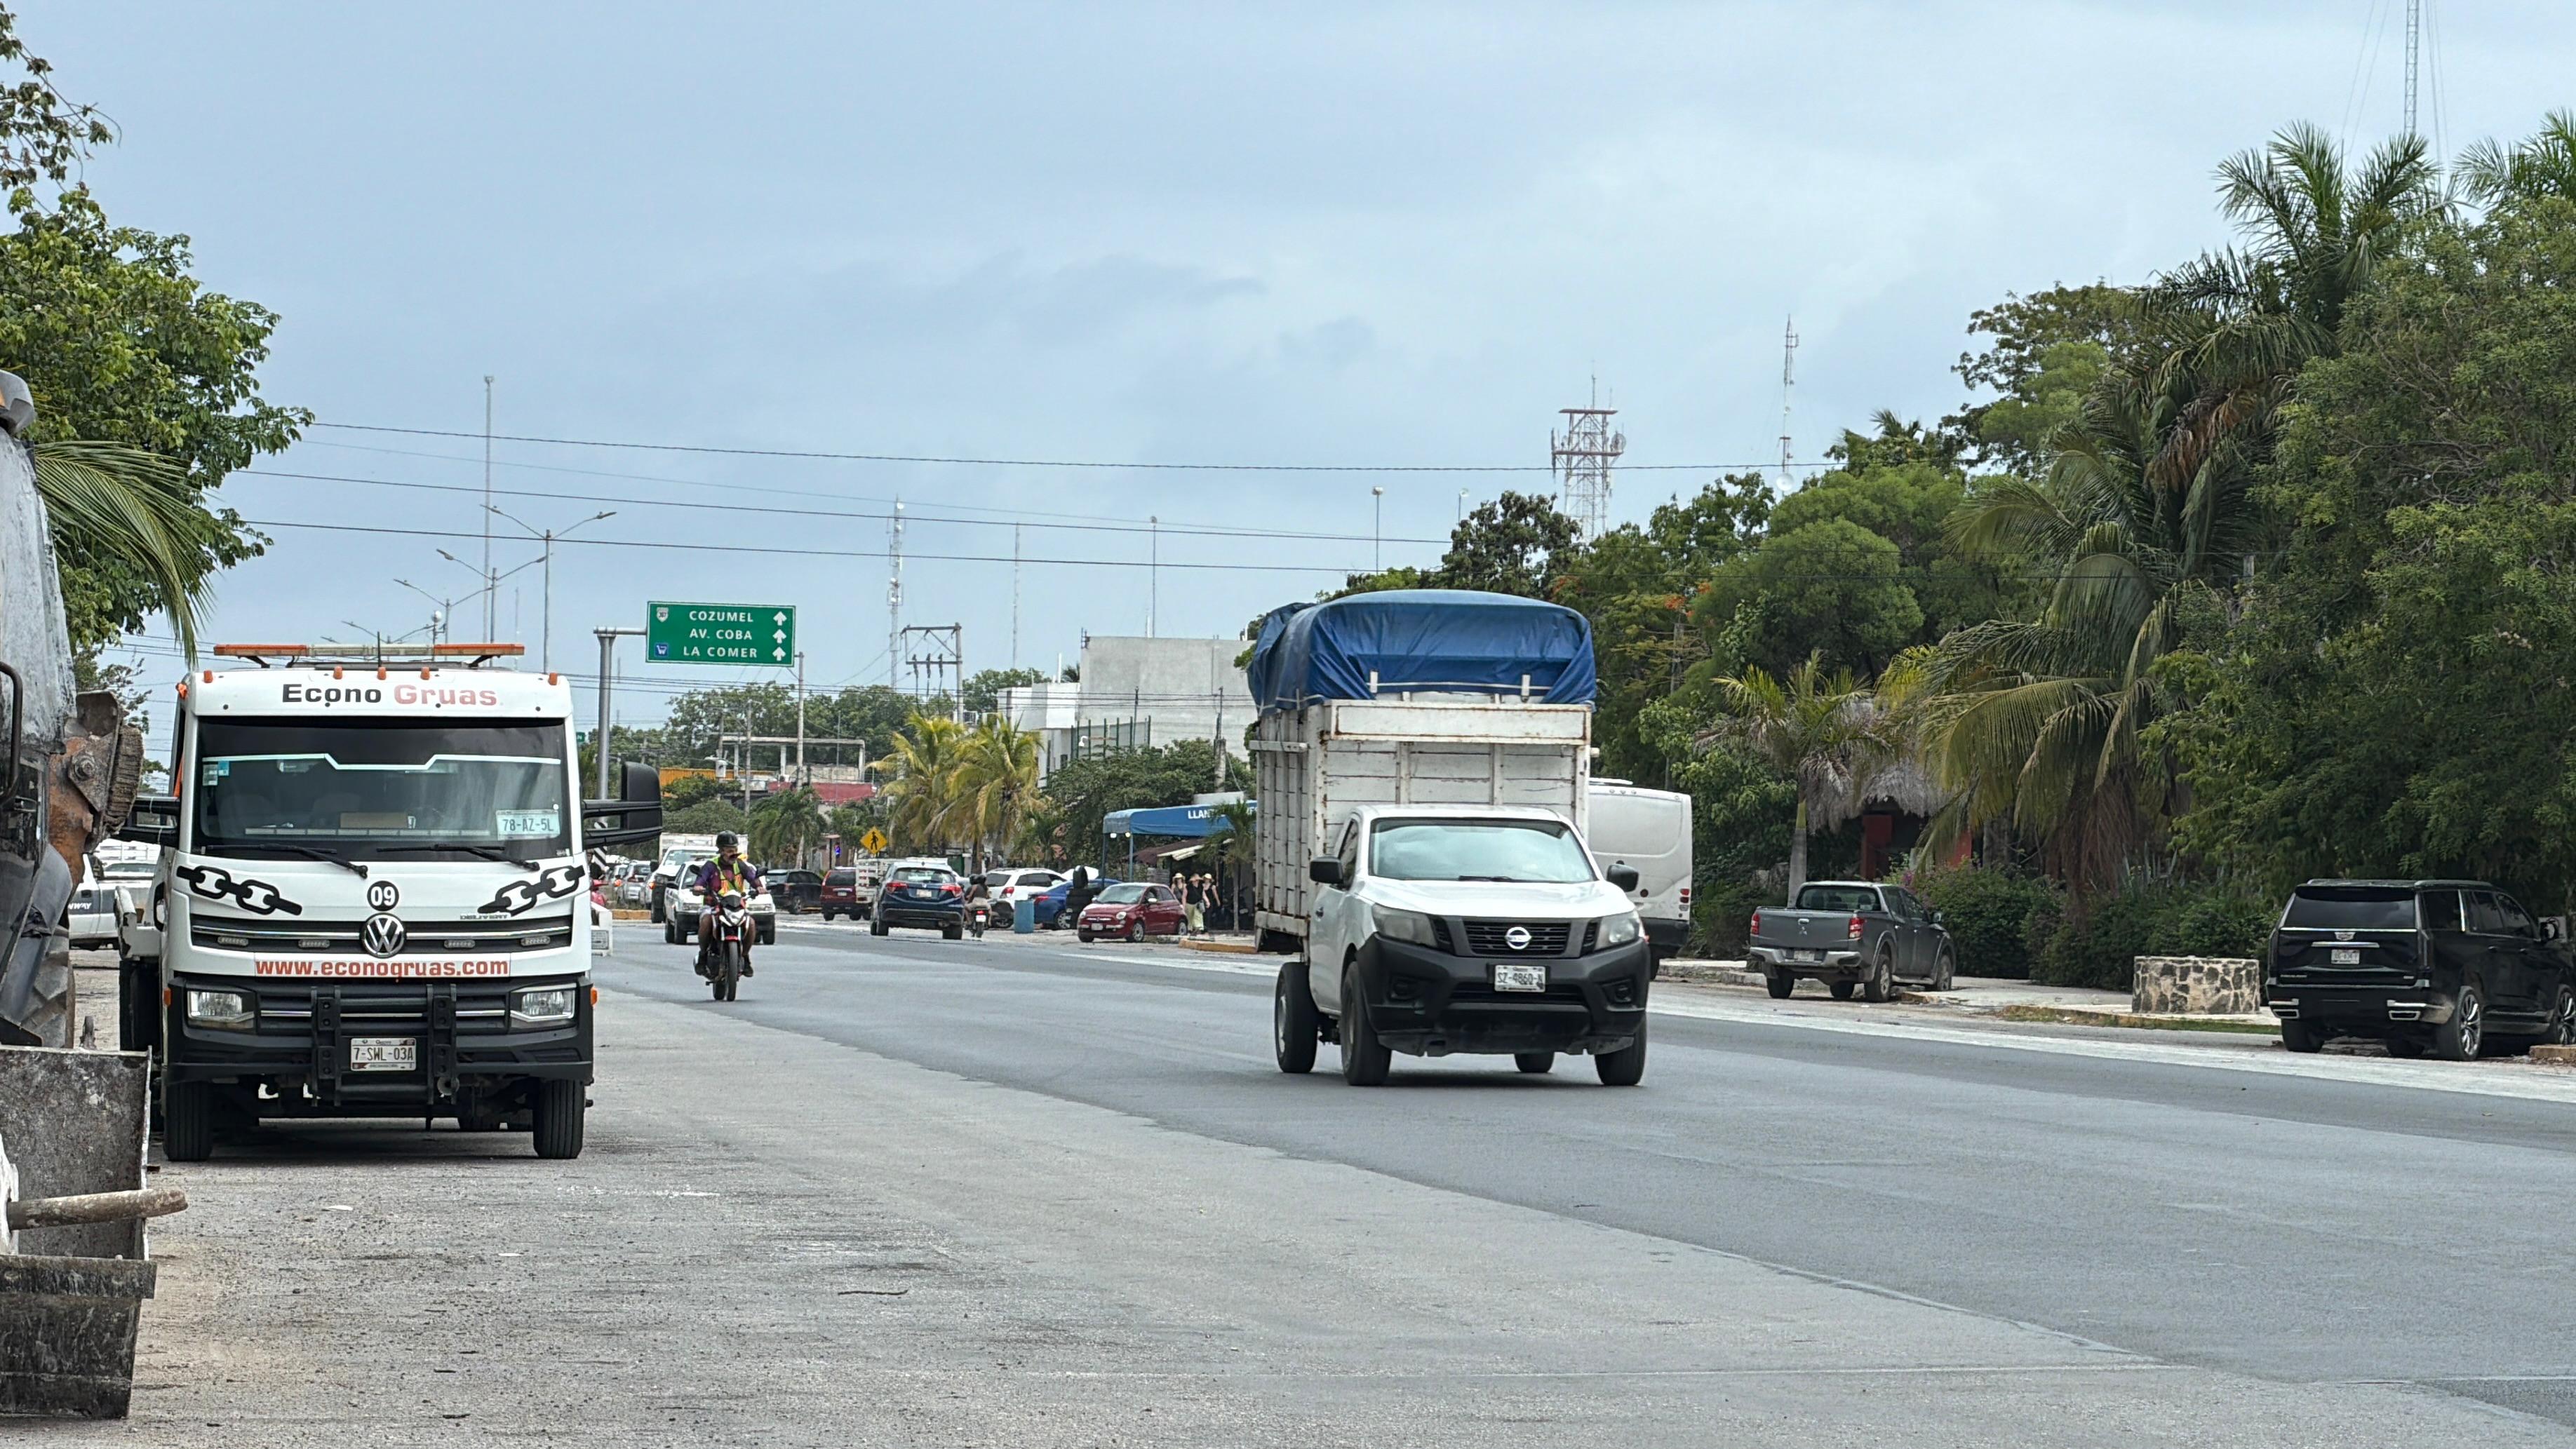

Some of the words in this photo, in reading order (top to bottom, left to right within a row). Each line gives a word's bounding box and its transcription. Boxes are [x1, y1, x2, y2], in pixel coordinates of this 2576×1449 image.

[688, 610, 753, 623] COZUMEL
[689, 628, 710, 639] AV.
[716, 629, 753, 640] COBA
[683, 646, 700, 656] LA
[706, 647, 758, 658] COMER
[282, 683, 382, 703] Econo
[394, 684, 497, 706] Gruas
[502, 818, 554, 832] 78-AZ-5L
[370, 886, 396, 906] 09
[255, 959, 509, 976] www.econogruas.com
[353, 1046, 413, 1061] 7-SWL-03A
